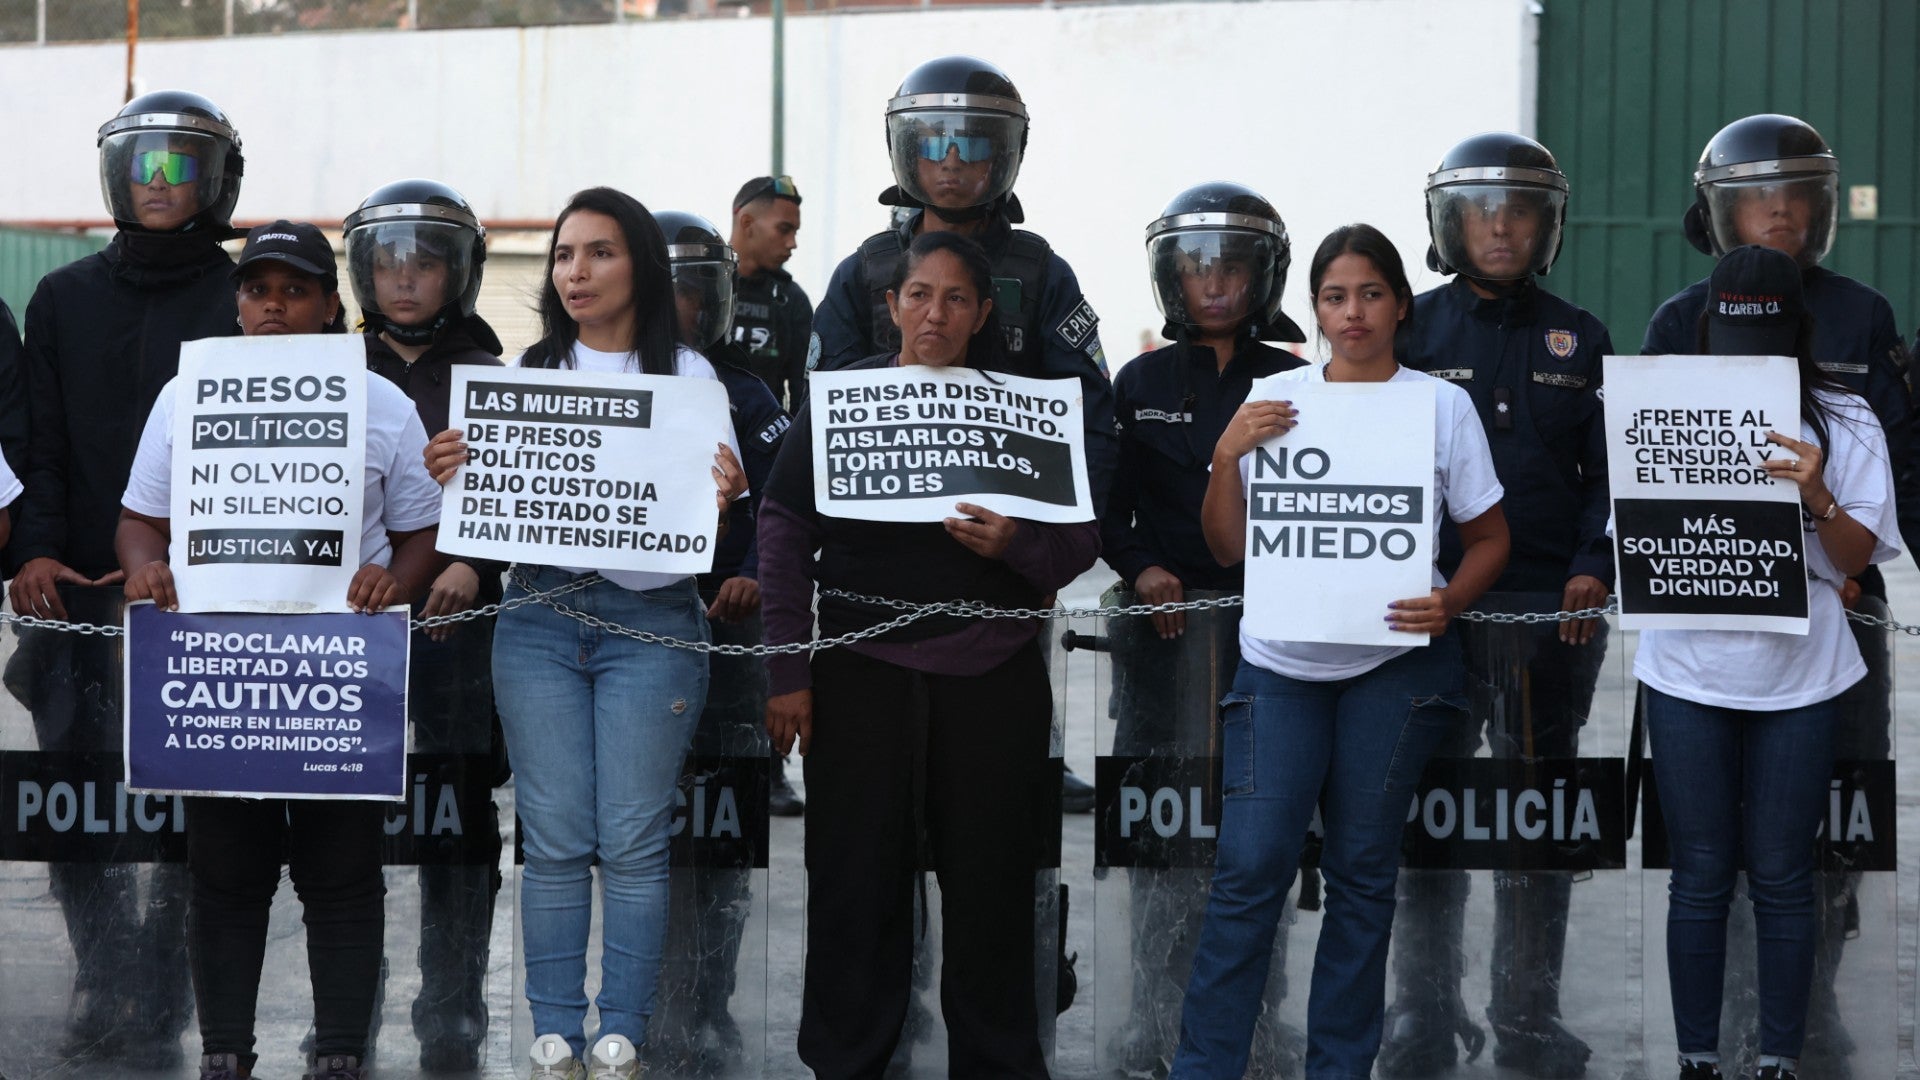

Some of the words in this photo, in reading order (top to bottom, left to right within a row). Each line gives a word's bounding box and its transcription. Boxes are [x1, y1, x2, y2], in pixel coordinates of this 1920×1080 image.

[1729, 303, 1763, 315] CARETA
[197, 375, 347, 404] PRESOS
[828, 383, 937, 405] PENSAR
[945, 384, 1068, 417] DISTINTO
[469, 391, 517, 412] LAS
[523, 394, 640, 419] MUERTES
[195, 416, 344, 442] POLÍTICOS
[829, 407, 868, 424] NO
[876, 405, 910, 421] ES
[918, 403, 956, 419] UN
[965, 406, 1065, 438] DELITO.
[1632, 409, 1732, 431] ¡FRENTE
[1740, 410, 1772, 427] AL
[467, 424, 499, 443] DE
[505, 425, 602, 449] PRESOS
[829, 428, 985, 450] AISLARLOS
[991, 434, 1008, 450] Y
[1624, 429, 1742, 450] SILENCIO,
[466, 446, 596, 472] POLÍTICOS
[829, 449, 1041, 480] TORTURARLOS,
[1255, 446, 1331, 480] NO
[1635, 448, 1751, 466] CENSURA
[1757, 450, 1772, 462] Y
[191, 464, 218, 485] NI
[230, 462, 350, 487] OLVIDO,
[831, 472, 857, 496] SÍ
[865, 475, 901, 495] LO
[909, 473, 944, 494] ES
[1637, 468, 1665, 484] EL
[1670, 468, 1775, 486] TERROR.
[464, 473, 524, 493] BAJO
[531, 475, 658, 502] CUSTODIA
[190, 497, 213, 516] NI
[224, 496, 349, 516] SILENCIO.
[461, 497, 508, 517] DEL
[514, 500, 610, 524] ESTADO
[616, 505, 647, 525] SE
[1257, 491, 1410, 516] TENEMOS
[1683, 514, 1736, 535] MÁS
[190, 539, 296, 558] ¡JUSTICIA
[304, 539, 340, 557] YA!
[458, 521, 511, 541] HAN
[518, 524, 707, 554] INTENSIFICADO
[1252, 525, 1416, 561] MIEDO
[1623, 538, 1798, 561] SOLIDARIDAD,
[1649, 558, 1753, 576] VERDAD
[1759, 560, 1775, 576] Y
[1650, 578, 1779, 598] DIGNIDAD!
[171, 631, 366, 656] “PROCLAMAR
[168, 656, 288, 677] LIBERTAD
[294, 660, 313, 677] A
[321, 660, 368, 678] LOS
[161, 680, 363, 712] CAUTIVOS
[166, 715, 178, 728] Y
[182, 715, 242, 729] PONER
[247, 716, 270, 730] EN
[275, 717, 362, 731] LIBERTAD
[165, 734, 180, 748] A
[186, 734, 225, 750] LOS
[231, 734, 367, 753] OPRIMIDOS”.
[304, 762, 337, 772] Lucas
[340, 762, 363, 772] 4:18
